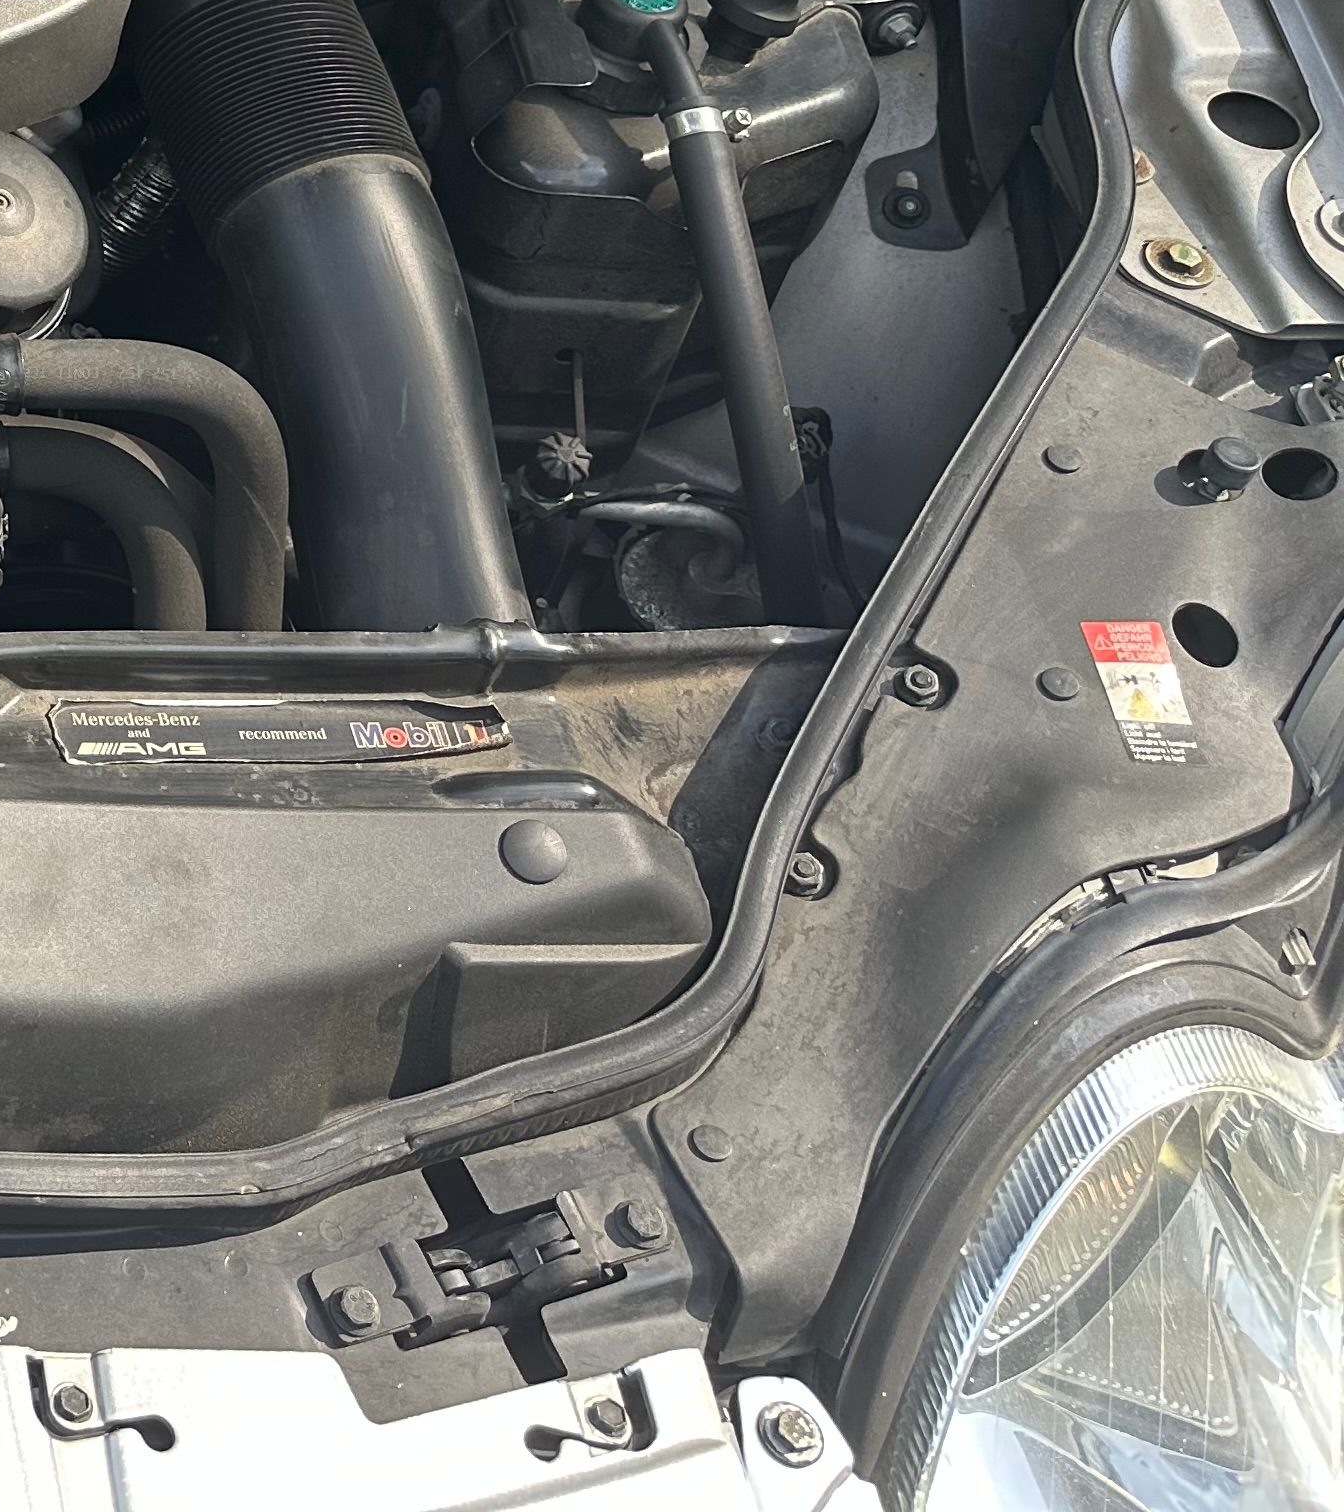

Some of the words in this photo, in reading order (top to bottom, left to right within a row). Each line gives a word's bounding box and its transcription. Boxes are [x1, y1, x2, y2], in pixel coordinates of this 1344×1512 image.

[1106, 624, 1151, 633] DANGER
[71, 712, 200, 728] Mercedes-Benz
[127, 728, 151, 739] and
[238, 727, 328, 741] recommend
[349, 720, 452, 749] Mobil
[115, 741, 207, 756] AMG
